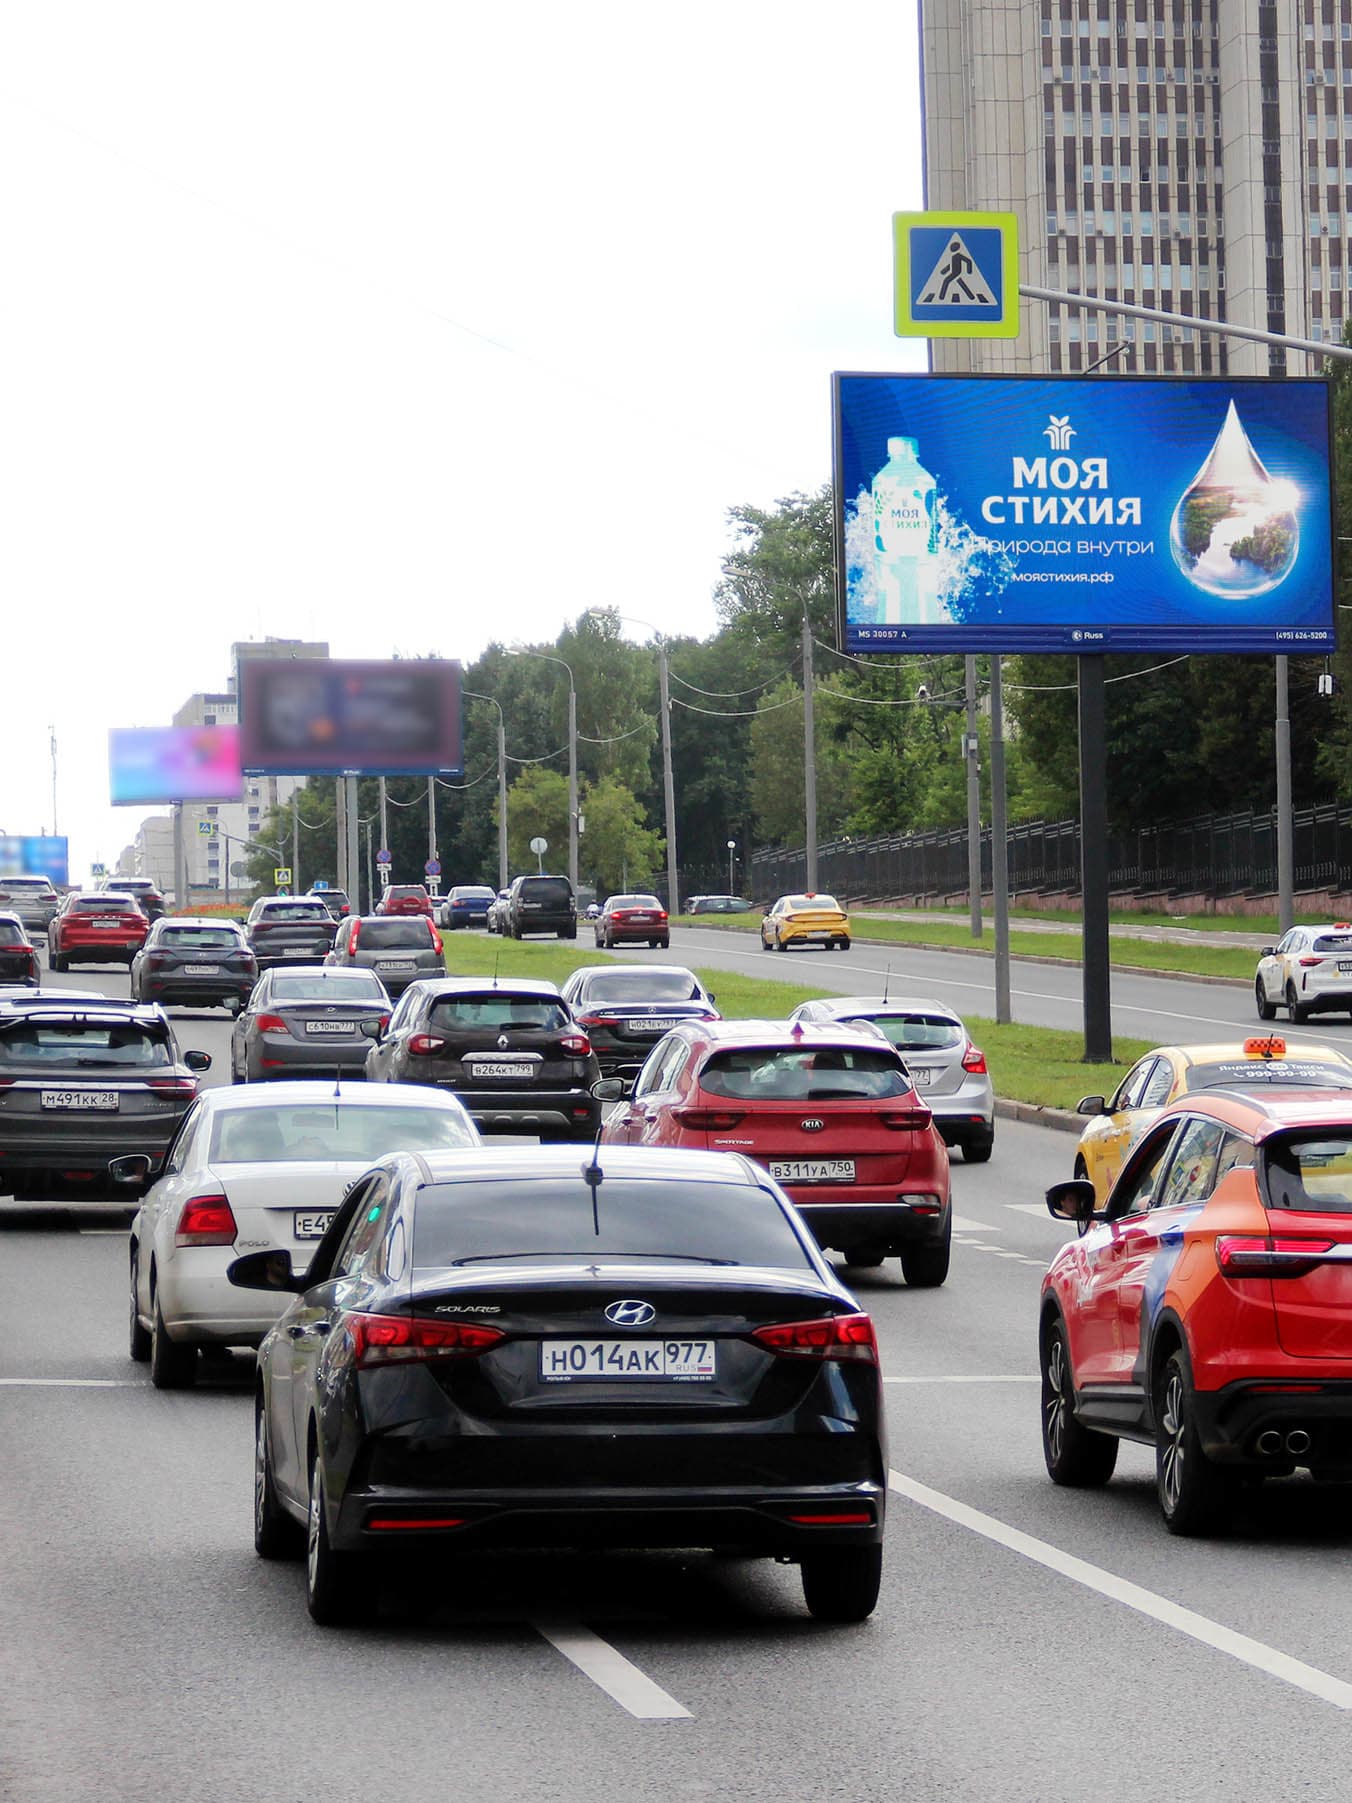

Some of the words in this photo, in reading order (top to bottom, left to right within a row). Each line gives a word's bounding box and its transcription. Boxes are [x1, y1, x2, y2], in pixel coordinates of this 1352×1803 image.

[1012, 456, 1109, 490] МОЯ
[891, 509, 919, 518] МОЯ
[981, 495, 1142, 525] СТИХИЯ
[1077, 540, 1154, 557] внутри
[1012, 572, 1114, 584] моястихия.рф
[1083, 631, 1104, 639] Russ
[1276, 631, 1294, 640] (495)
[1294, 631, 1328, 640] 626-5200
[46, 1093, 98, 1105] М491КК
[102, 1093, 114, 1102] 28
[805, 1120, 820, 1128] KIA
[774, 1163, 828, 1178] В311УА
[830, 1162, 851, 1173] 750
[434, 1305, 502, 1314] SOLARIS
[552, 1343, 660, 1371] Н014АК
[666, 1342, 707, 1363] 977
